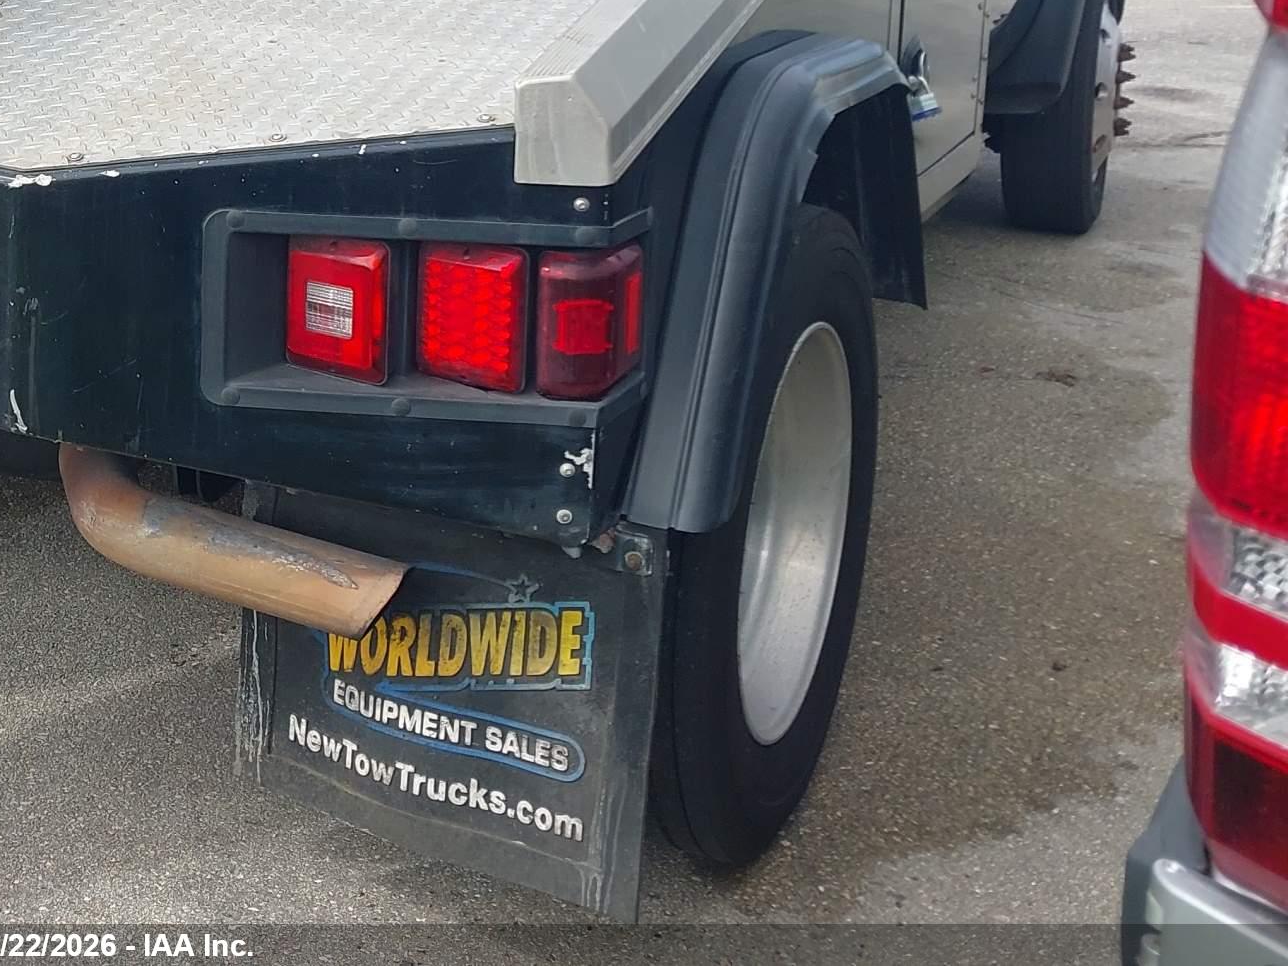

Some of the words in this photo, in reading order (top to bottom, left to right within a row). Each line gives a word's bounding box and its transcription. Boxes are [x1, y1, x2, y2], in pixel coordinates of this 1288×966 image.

[328, 610, 584, 677] WORLDWIDE
[333, 679, 477, 746] EQUIPMENT
[484, 725, 569, 772] SALES
[288, 714, 584, 842] NewTowTrucks.com
